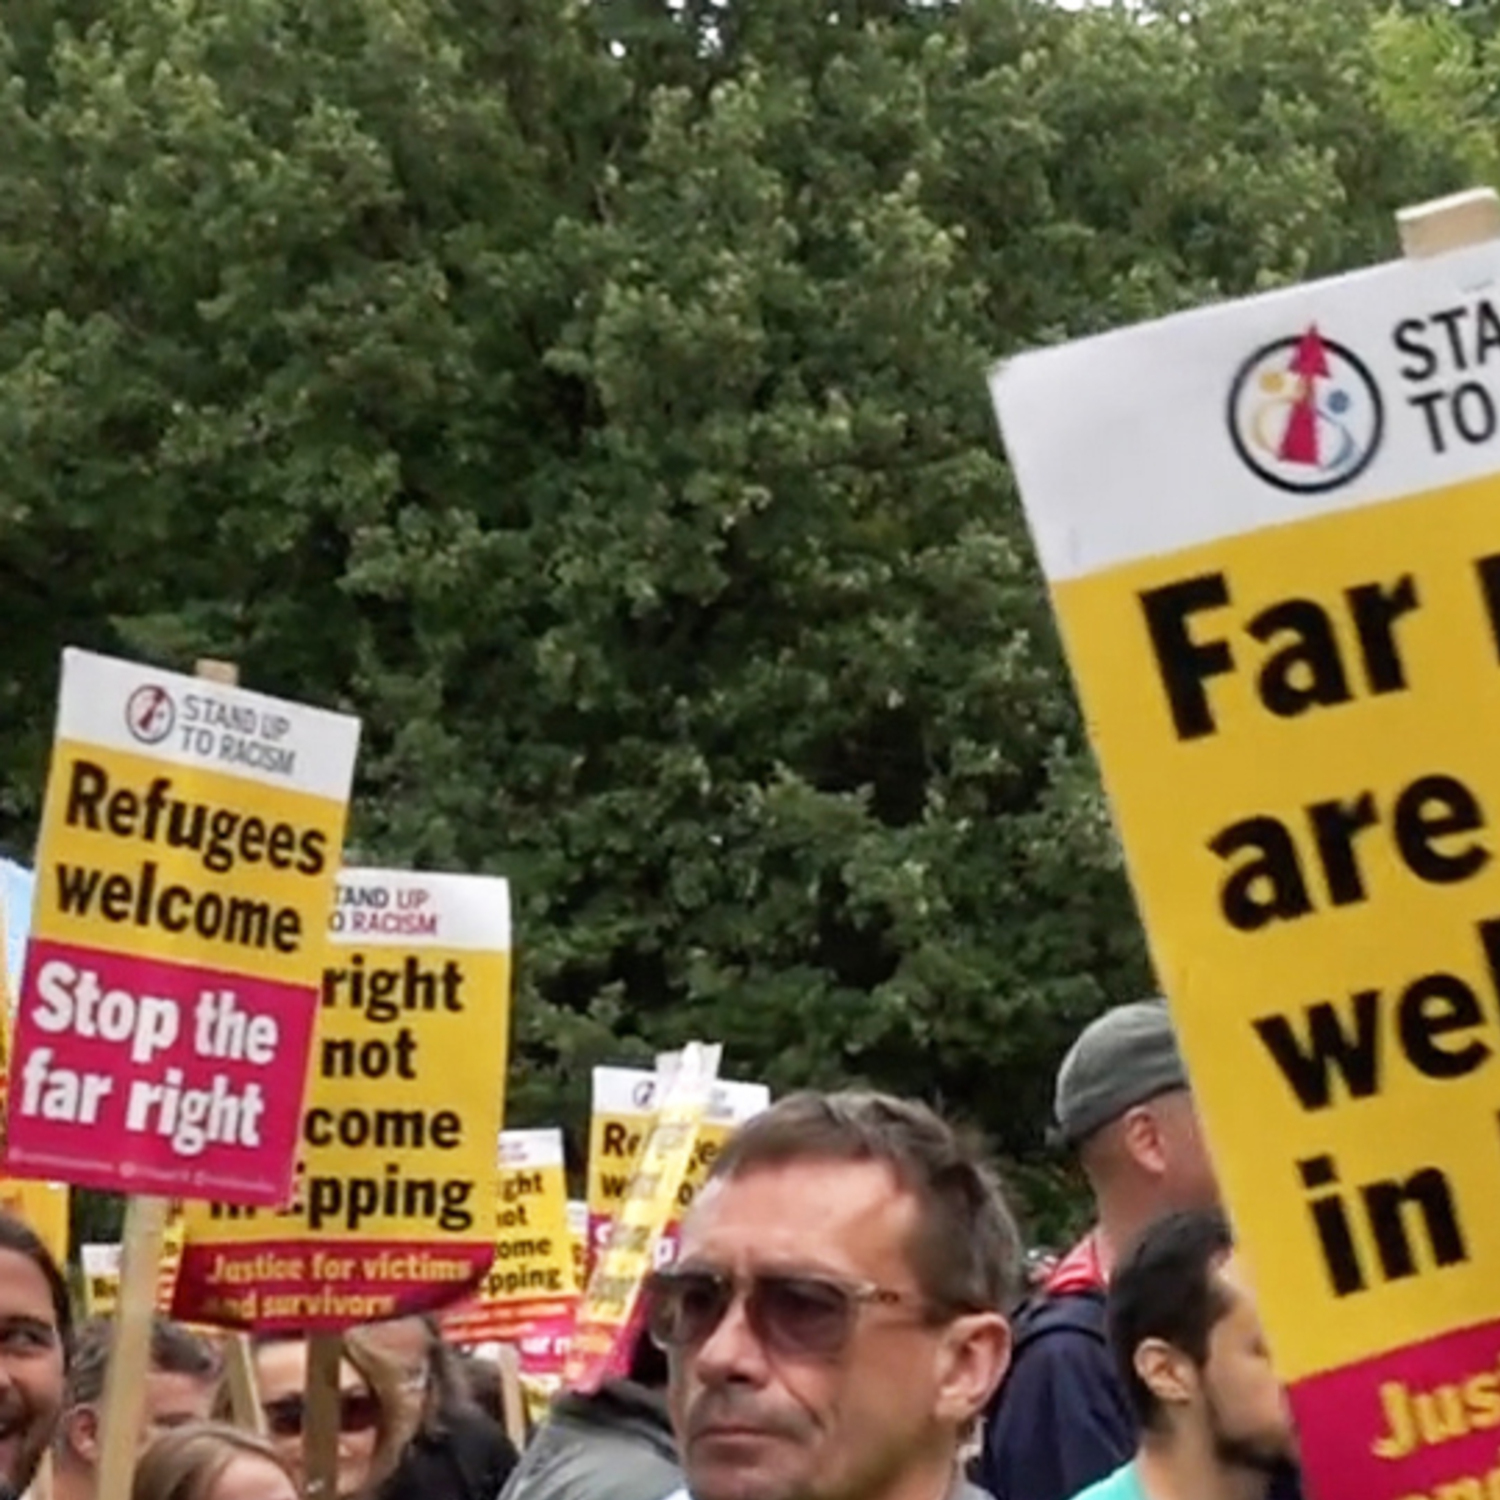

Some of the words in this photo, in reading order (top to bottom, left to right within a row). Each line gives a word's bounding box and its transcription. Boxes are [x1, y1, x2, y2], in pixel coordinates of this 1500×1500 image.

[1409, 380, 1499, 455] TO
[1136, 570, 1420, 742] Far
[180, 724, 214, 756] TO
[219, 733, 296, 775] RACISM
[181, 693, 257, 735] STAND
[261, 712, 291, 741] UP
[64, 761, 326, 876] Refugees
[1208, 771, 1495, 933] are
[56, 861, 303, 954] welcome
[327, 910, 345, 933] O
[351, 910, 438, 936] RACISM
[334, 884, 390, 909] TAND
[396, 888, 431, 910] UP
[33, 961, 179, 1064] Stop
[194, 990, 279, 1064] the
[321, 953, 464, 1024] right
[321, 1027, 418, 1080] not
[21, 1048, 113, 1125] far
[125, 1070, 265, 1156] right
[303, 1107, 463, 1150] come
[297, 1162, 475, 1233] pping
[499, 1171, 545, 1203] ght
[1296, 1153, 1469, 1299] in
[205, 1252, 304, 1284] Justice
[312, 1251, 356, 1281] for
[363, 1250, 472, 1281] victims
[488, 1264, 563, 1298] pping
